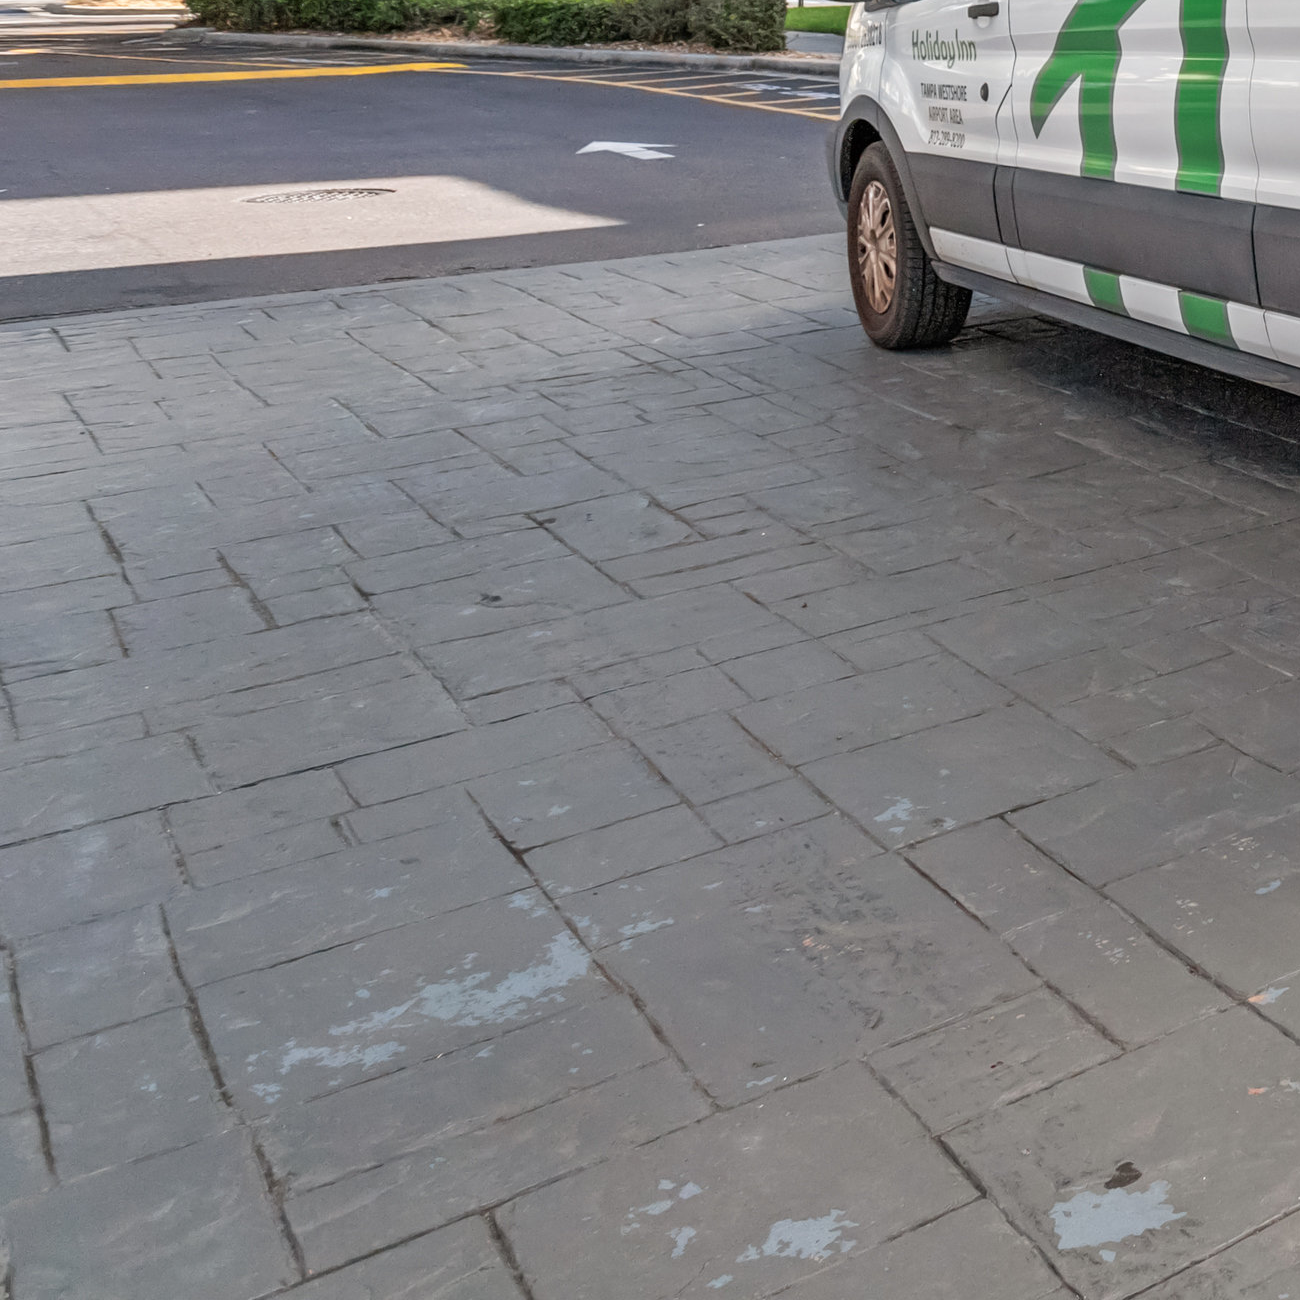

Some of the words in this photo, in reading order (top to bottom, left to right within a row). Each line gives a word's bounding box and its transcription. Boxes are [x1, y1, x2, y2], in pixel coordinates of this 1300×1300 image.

[912, 30, 956, 69] Holiday
[956, 29, 977, 61] Inn
[920, 82, 938, 99] TAMPA
[938, 84, 967, 101] WESTSHORE
